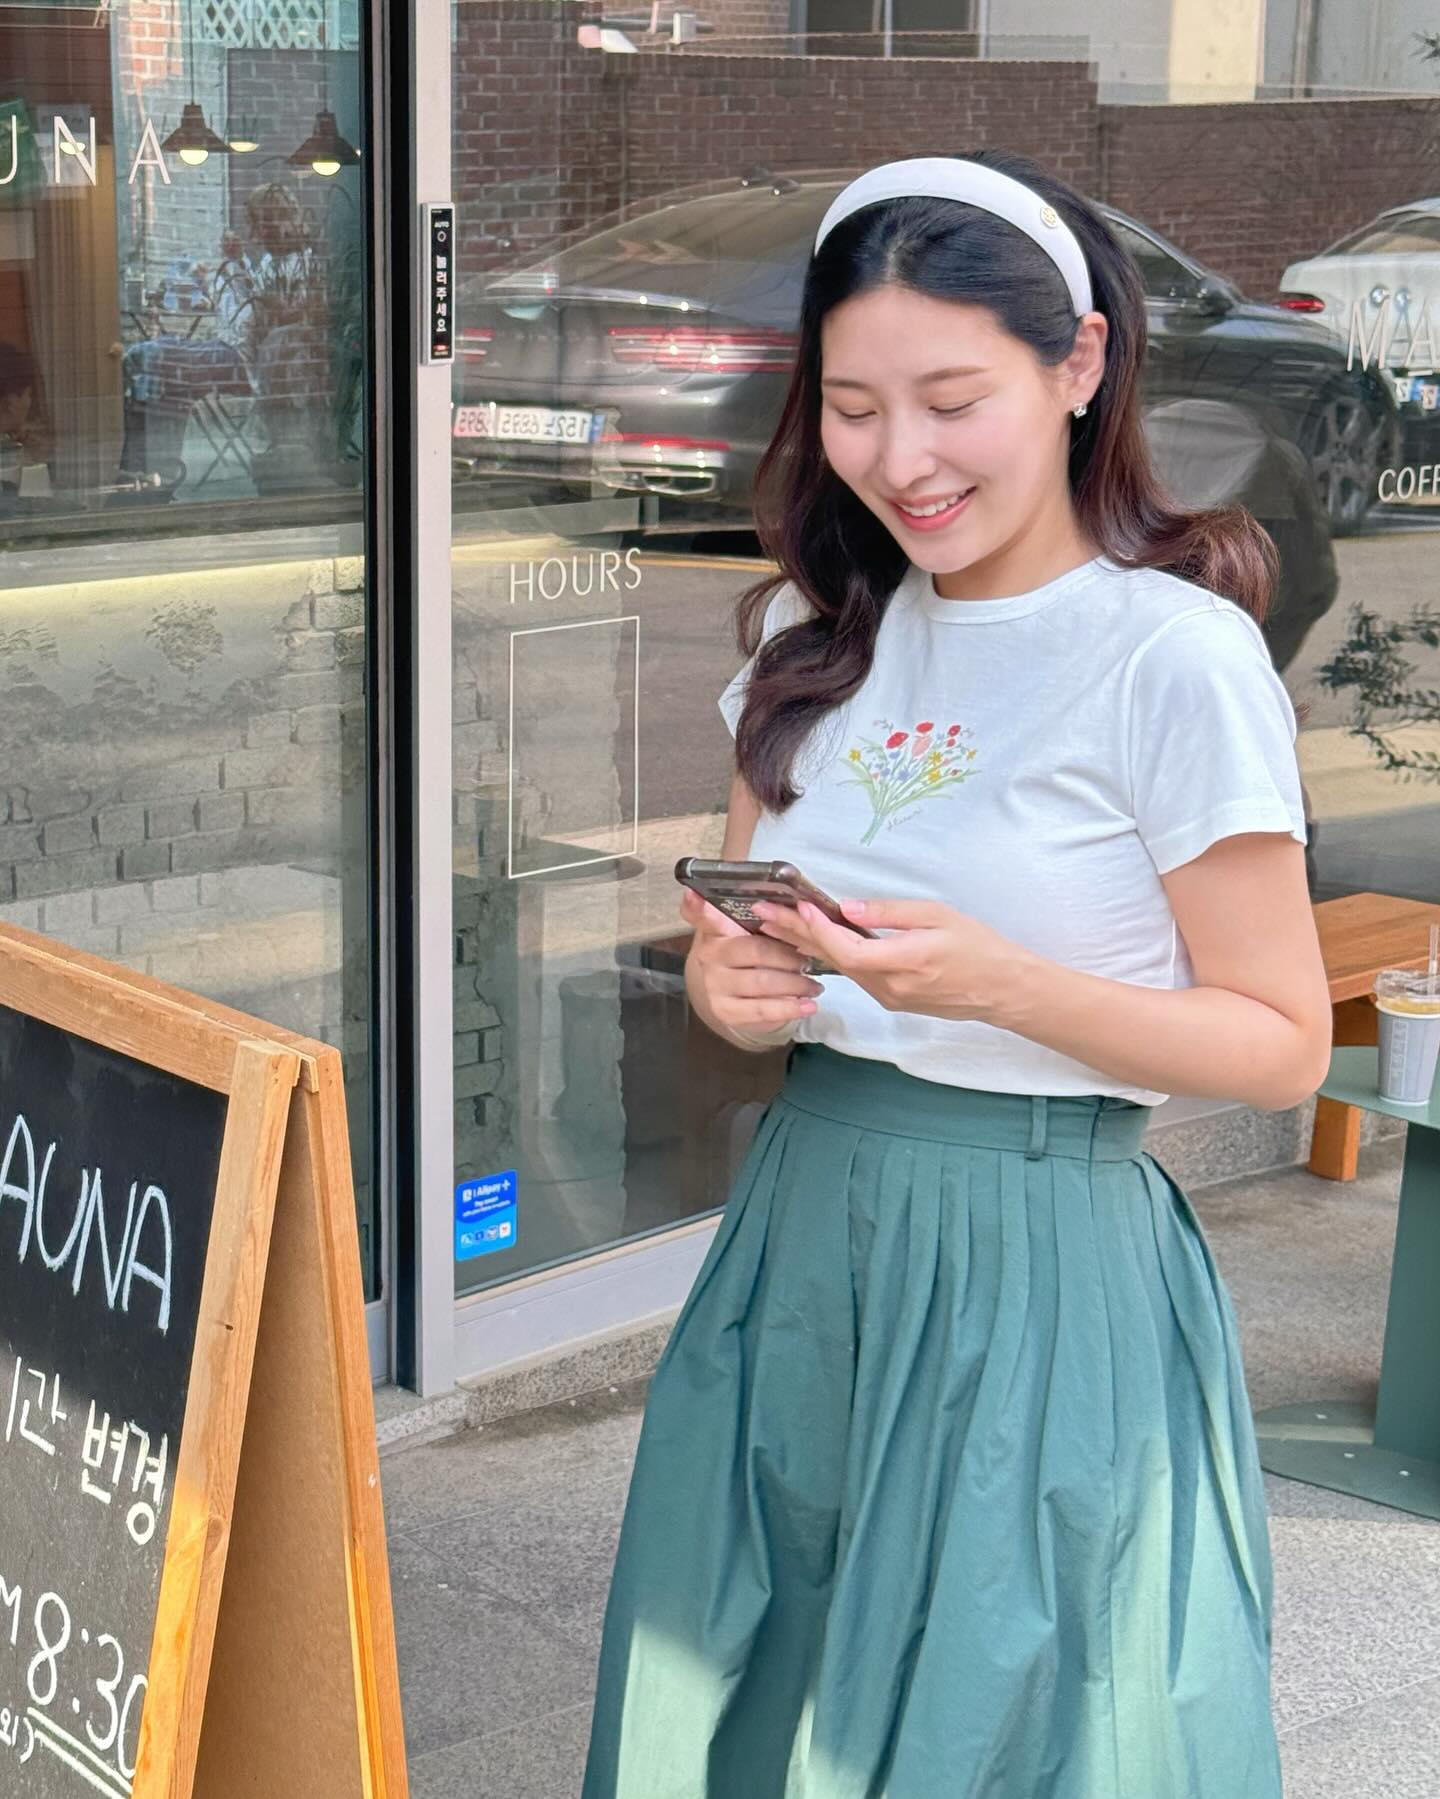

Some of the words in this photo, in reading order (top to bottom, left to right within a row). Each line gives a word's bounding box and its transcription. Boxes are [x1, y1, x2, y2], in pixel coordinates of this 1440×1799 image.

[510, 547, 643, 604] HOURS
[0, 1114, 172, 1335] AUNA
[81, 1399, 168, 1546] 변경
